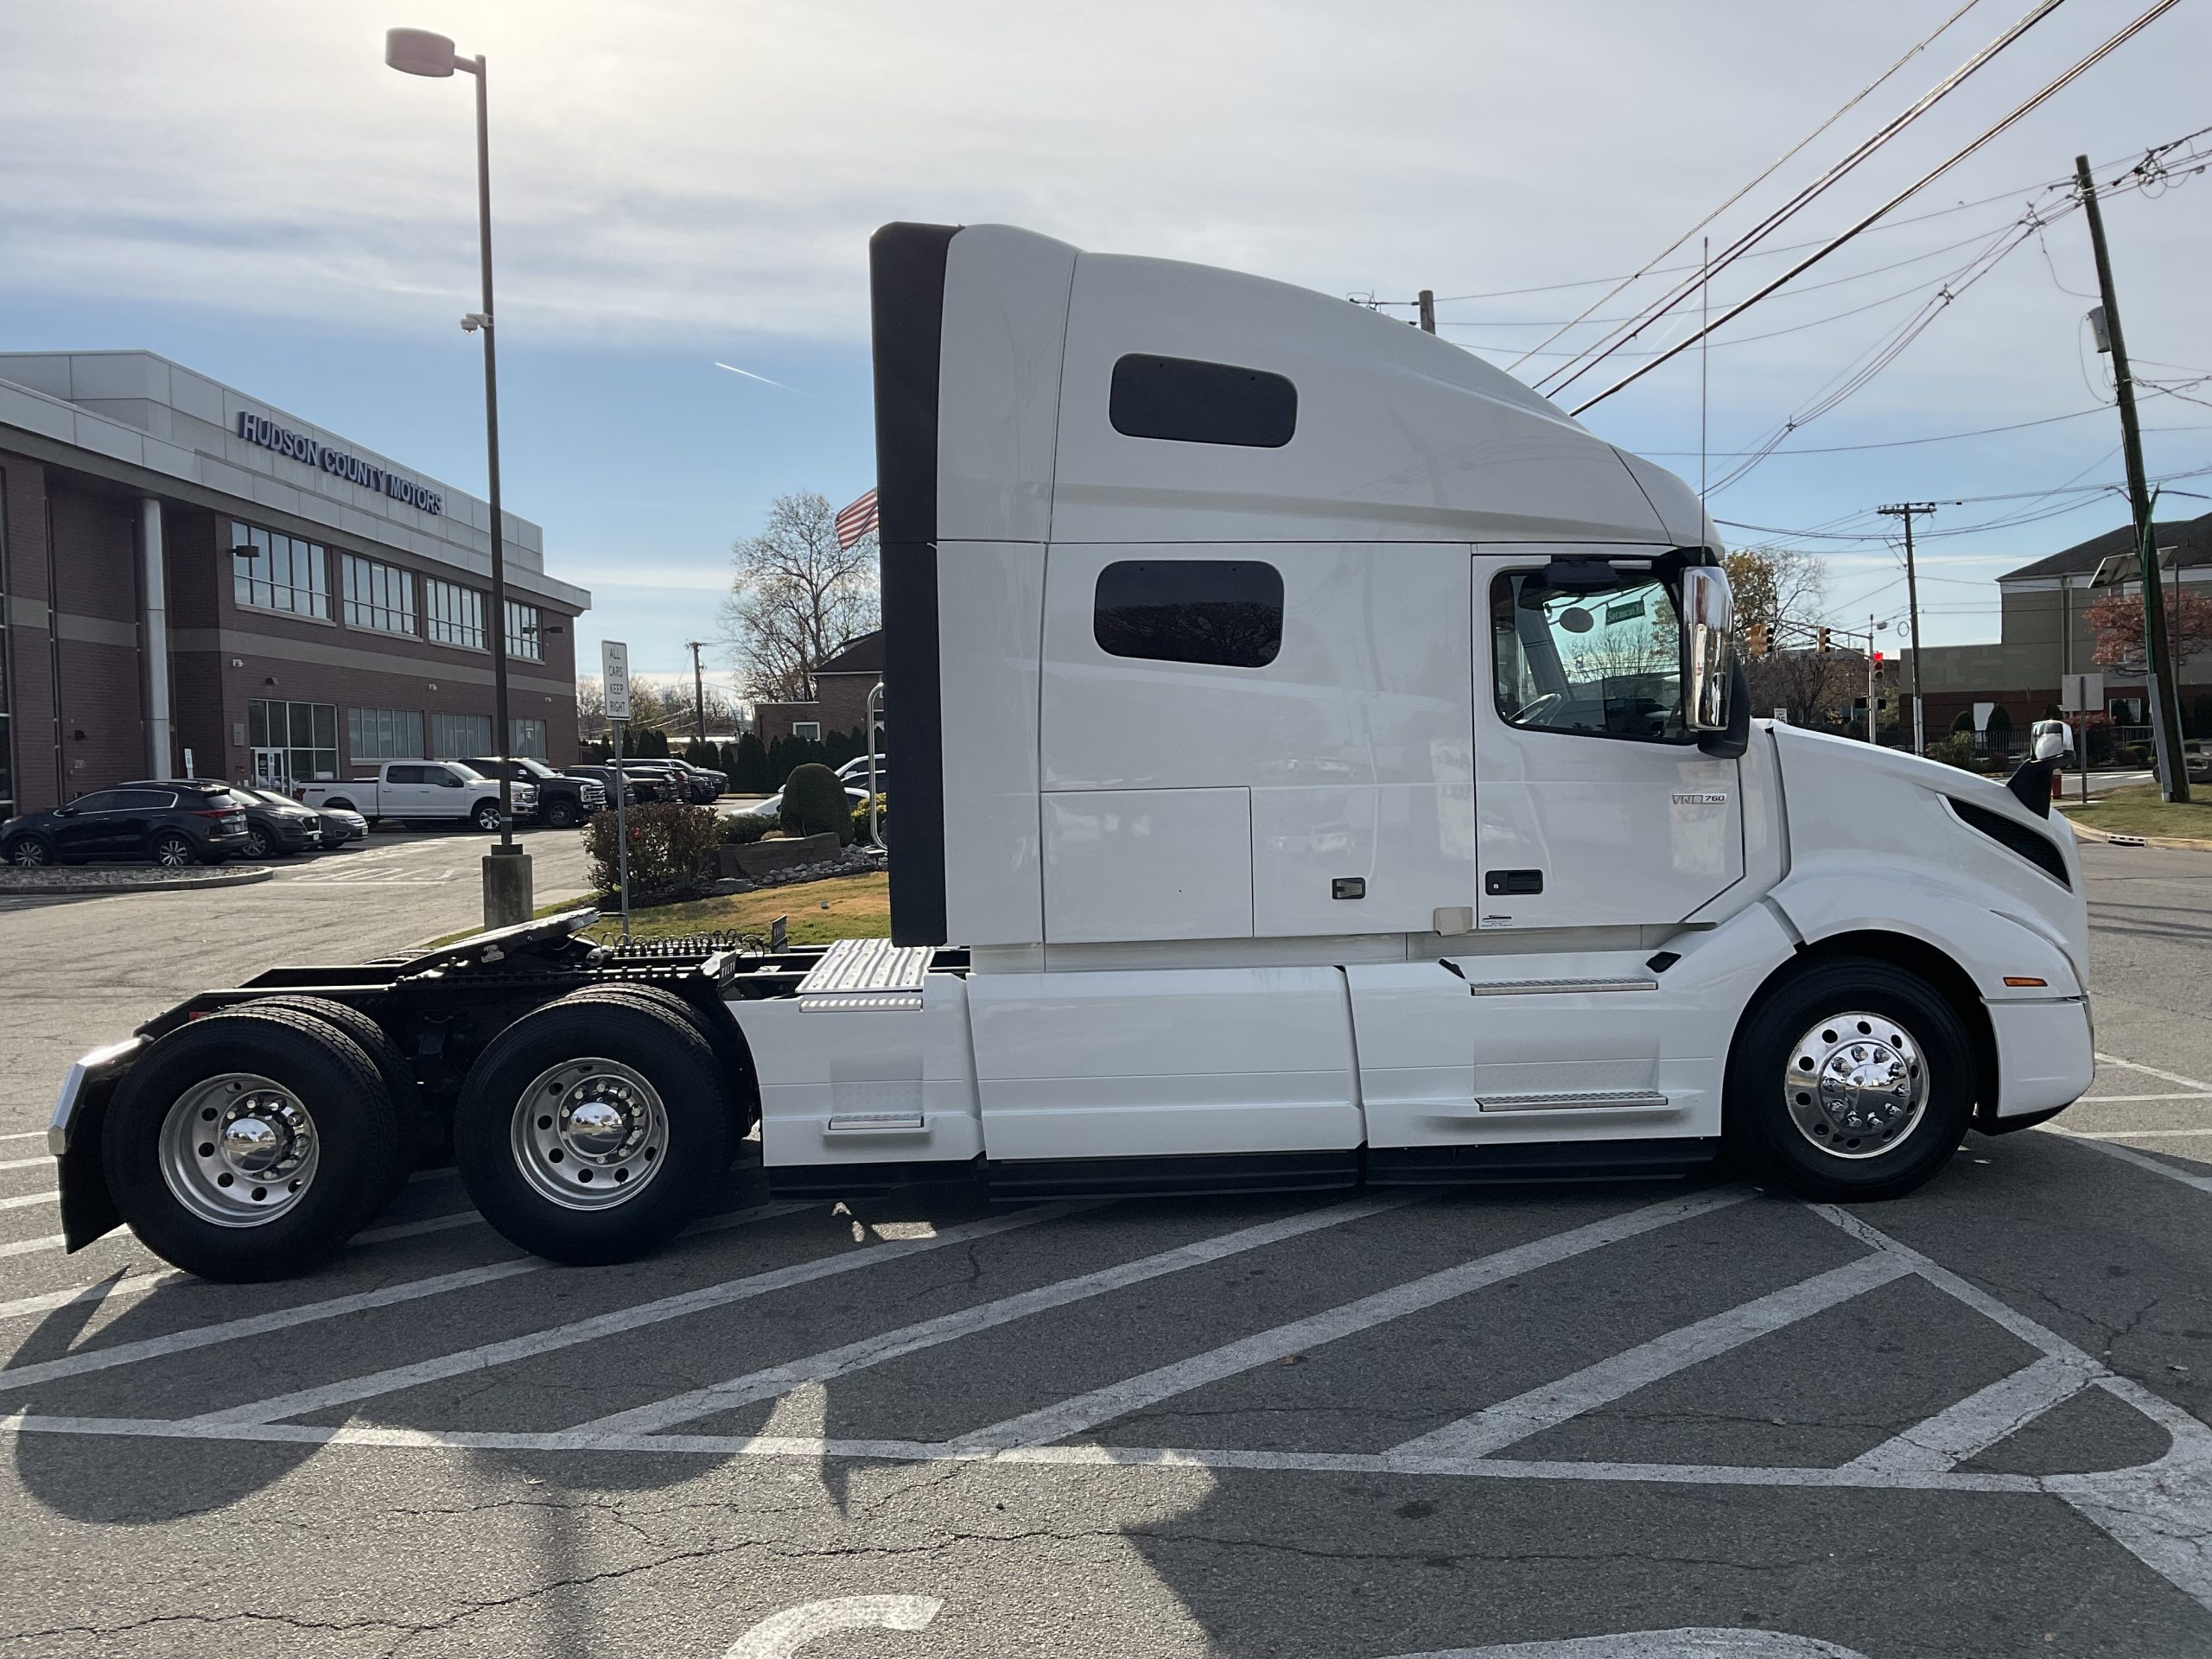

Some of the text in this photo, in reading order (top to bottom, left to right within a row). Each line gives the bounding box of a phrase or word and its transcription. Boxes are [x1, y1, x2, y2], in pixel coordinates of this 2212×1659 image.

[239, 411, 442, 515] HUDSON COUNTY MOTORS
[609, 646, 620, 659] ALL
[608, 665, 623, 677] CARS
[609, 683, 624, 695] KEEP
[609, 701, 626, 713] RIGHT
